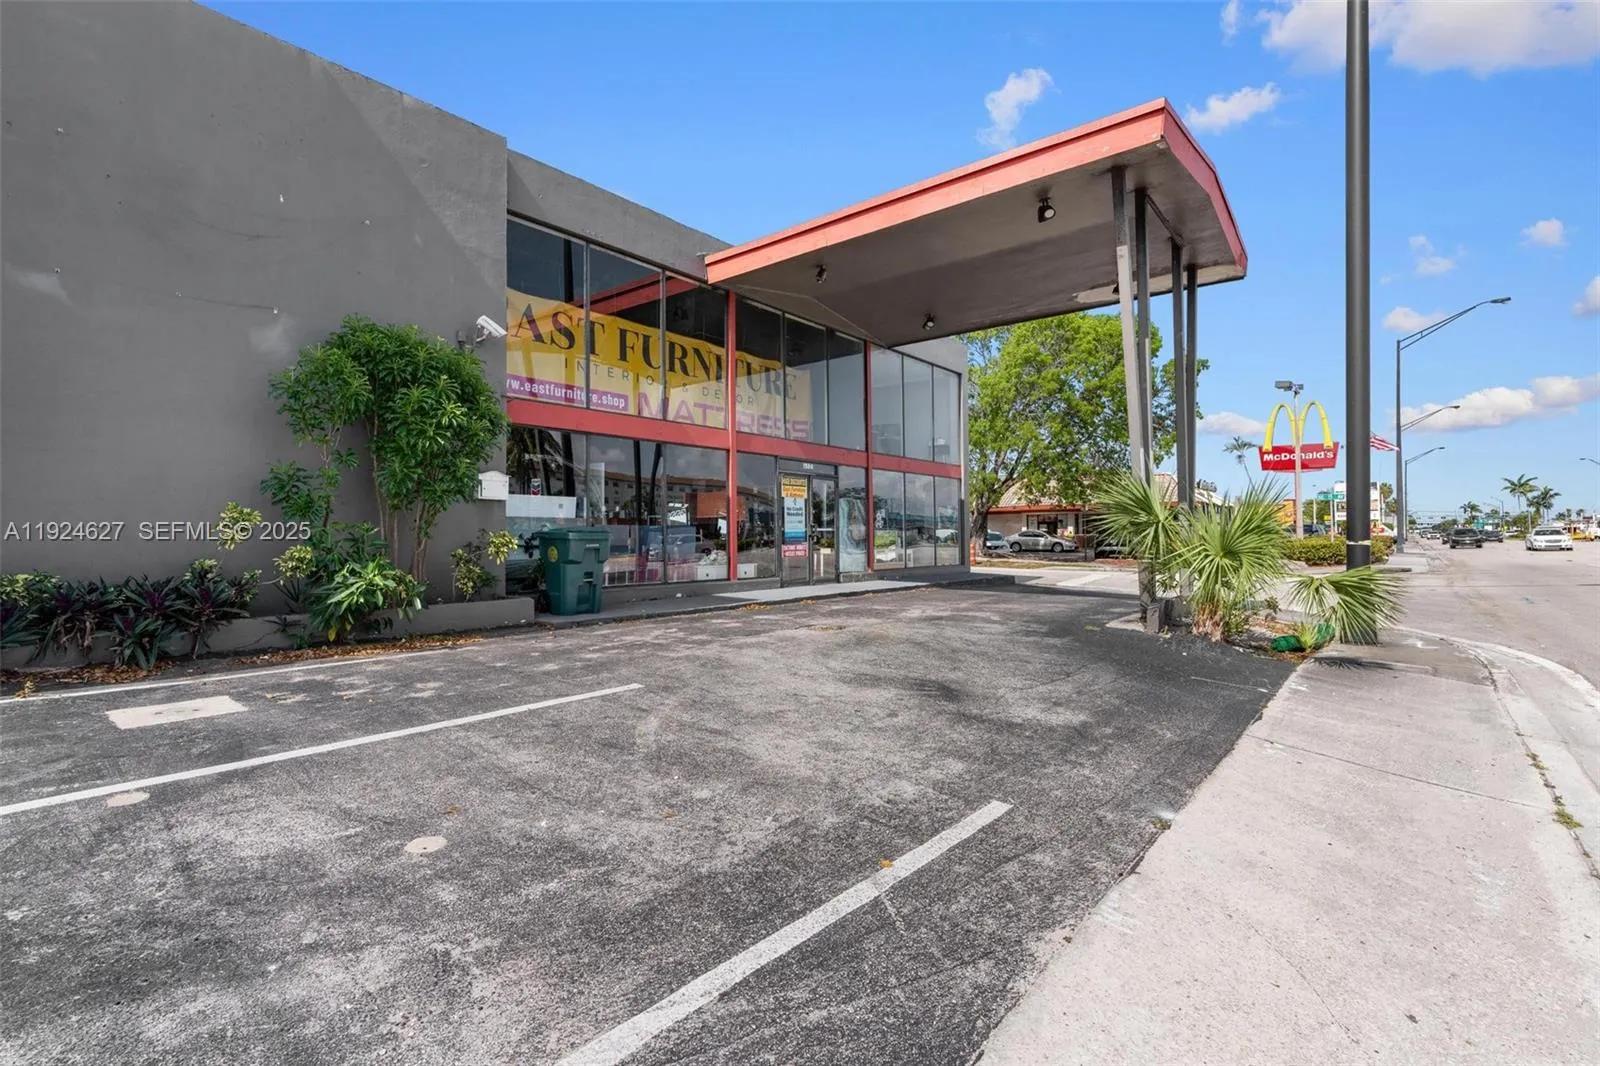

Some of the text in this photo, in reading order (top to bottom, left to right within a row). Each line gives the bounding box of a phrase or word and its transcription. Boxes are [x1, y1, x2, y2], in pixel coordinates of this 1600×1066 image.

[506, 297, 605, 356] AST
[564, 357, 667, 388] INTERIO
[702, 385, 755, 406] DÉOR
[1263, 450, 1334, 461] McDonald's
